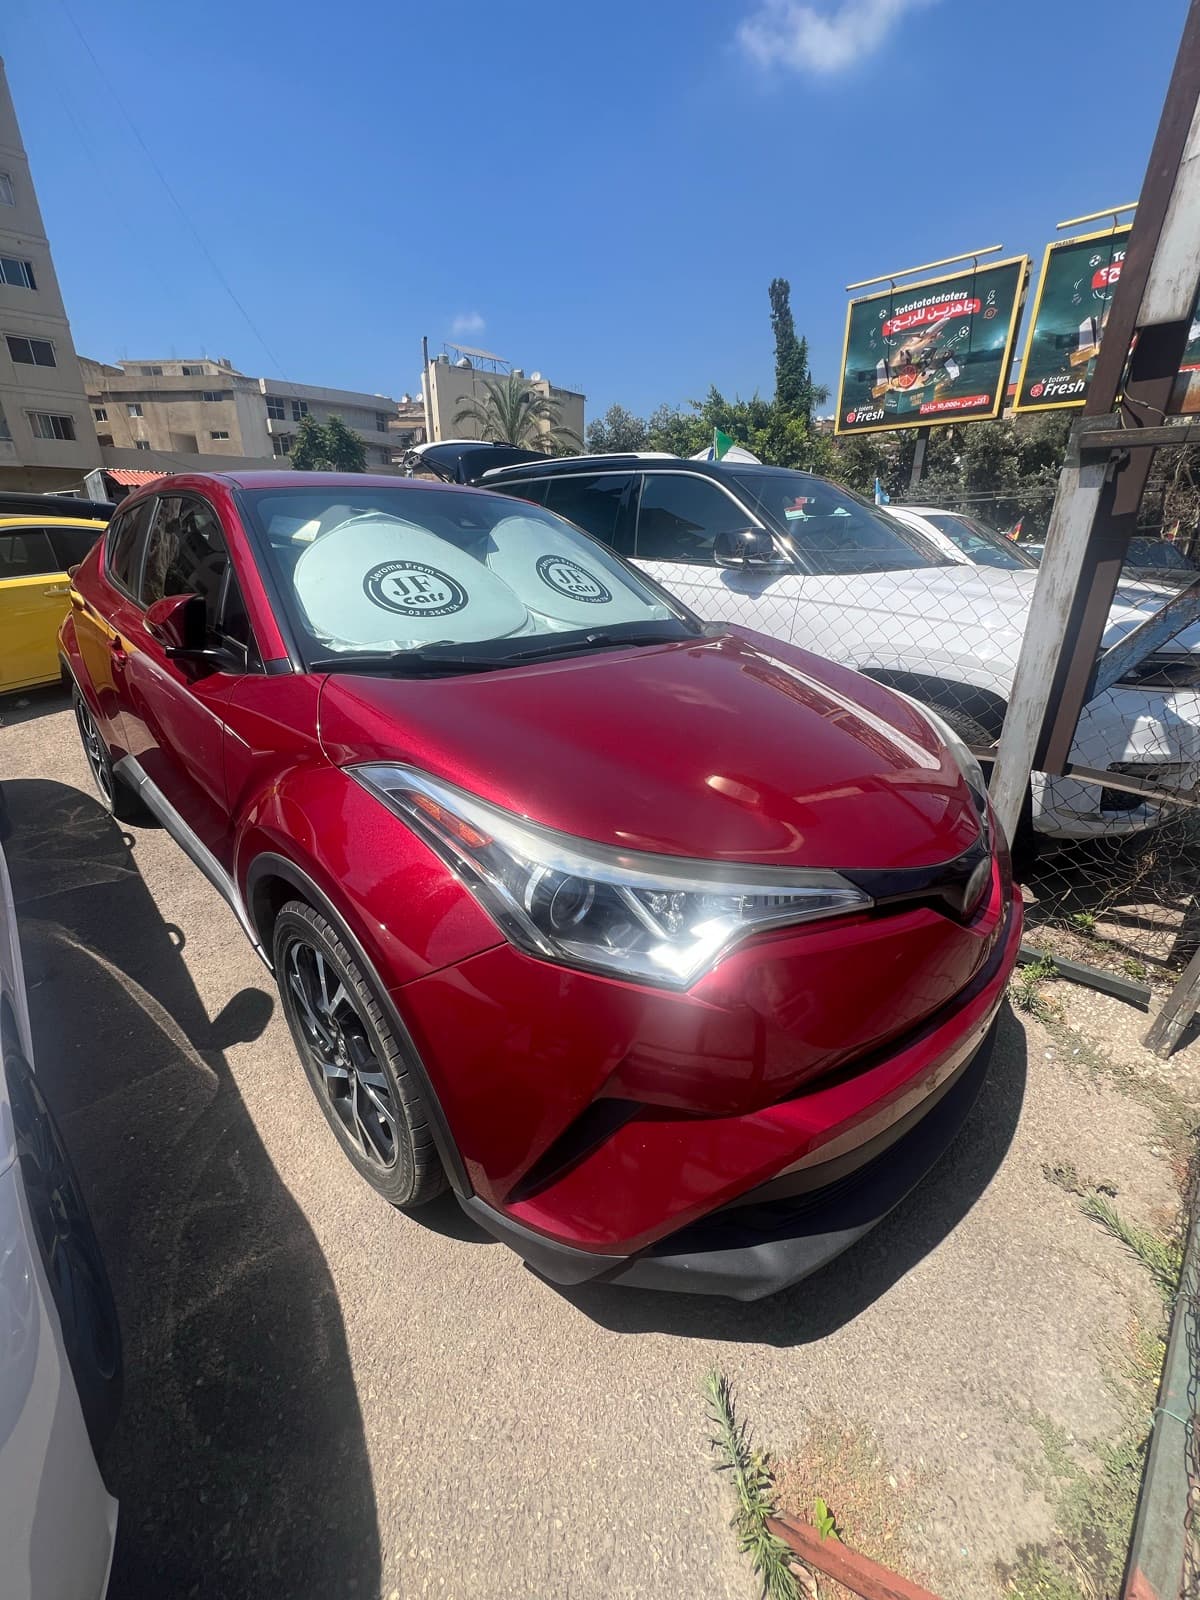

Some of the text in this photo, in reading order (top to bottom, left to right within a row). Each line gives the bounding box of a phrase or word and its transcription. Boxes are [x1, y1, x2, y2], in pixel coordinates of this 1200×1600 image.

[927, 299, 976, 320] جاهزين
[1048, 375, 1071, 384] toters
[1043, 379, 1085, 397] Fresh
[855, 408, 885, 423] Fresh
[369, 562, 403, 582] Jerome
[552, 568, 584, 584] JF
[387, 574, 432, 596] JF
[568, 585, 596, 593] cars
[403, 592, 445, 605] cars
